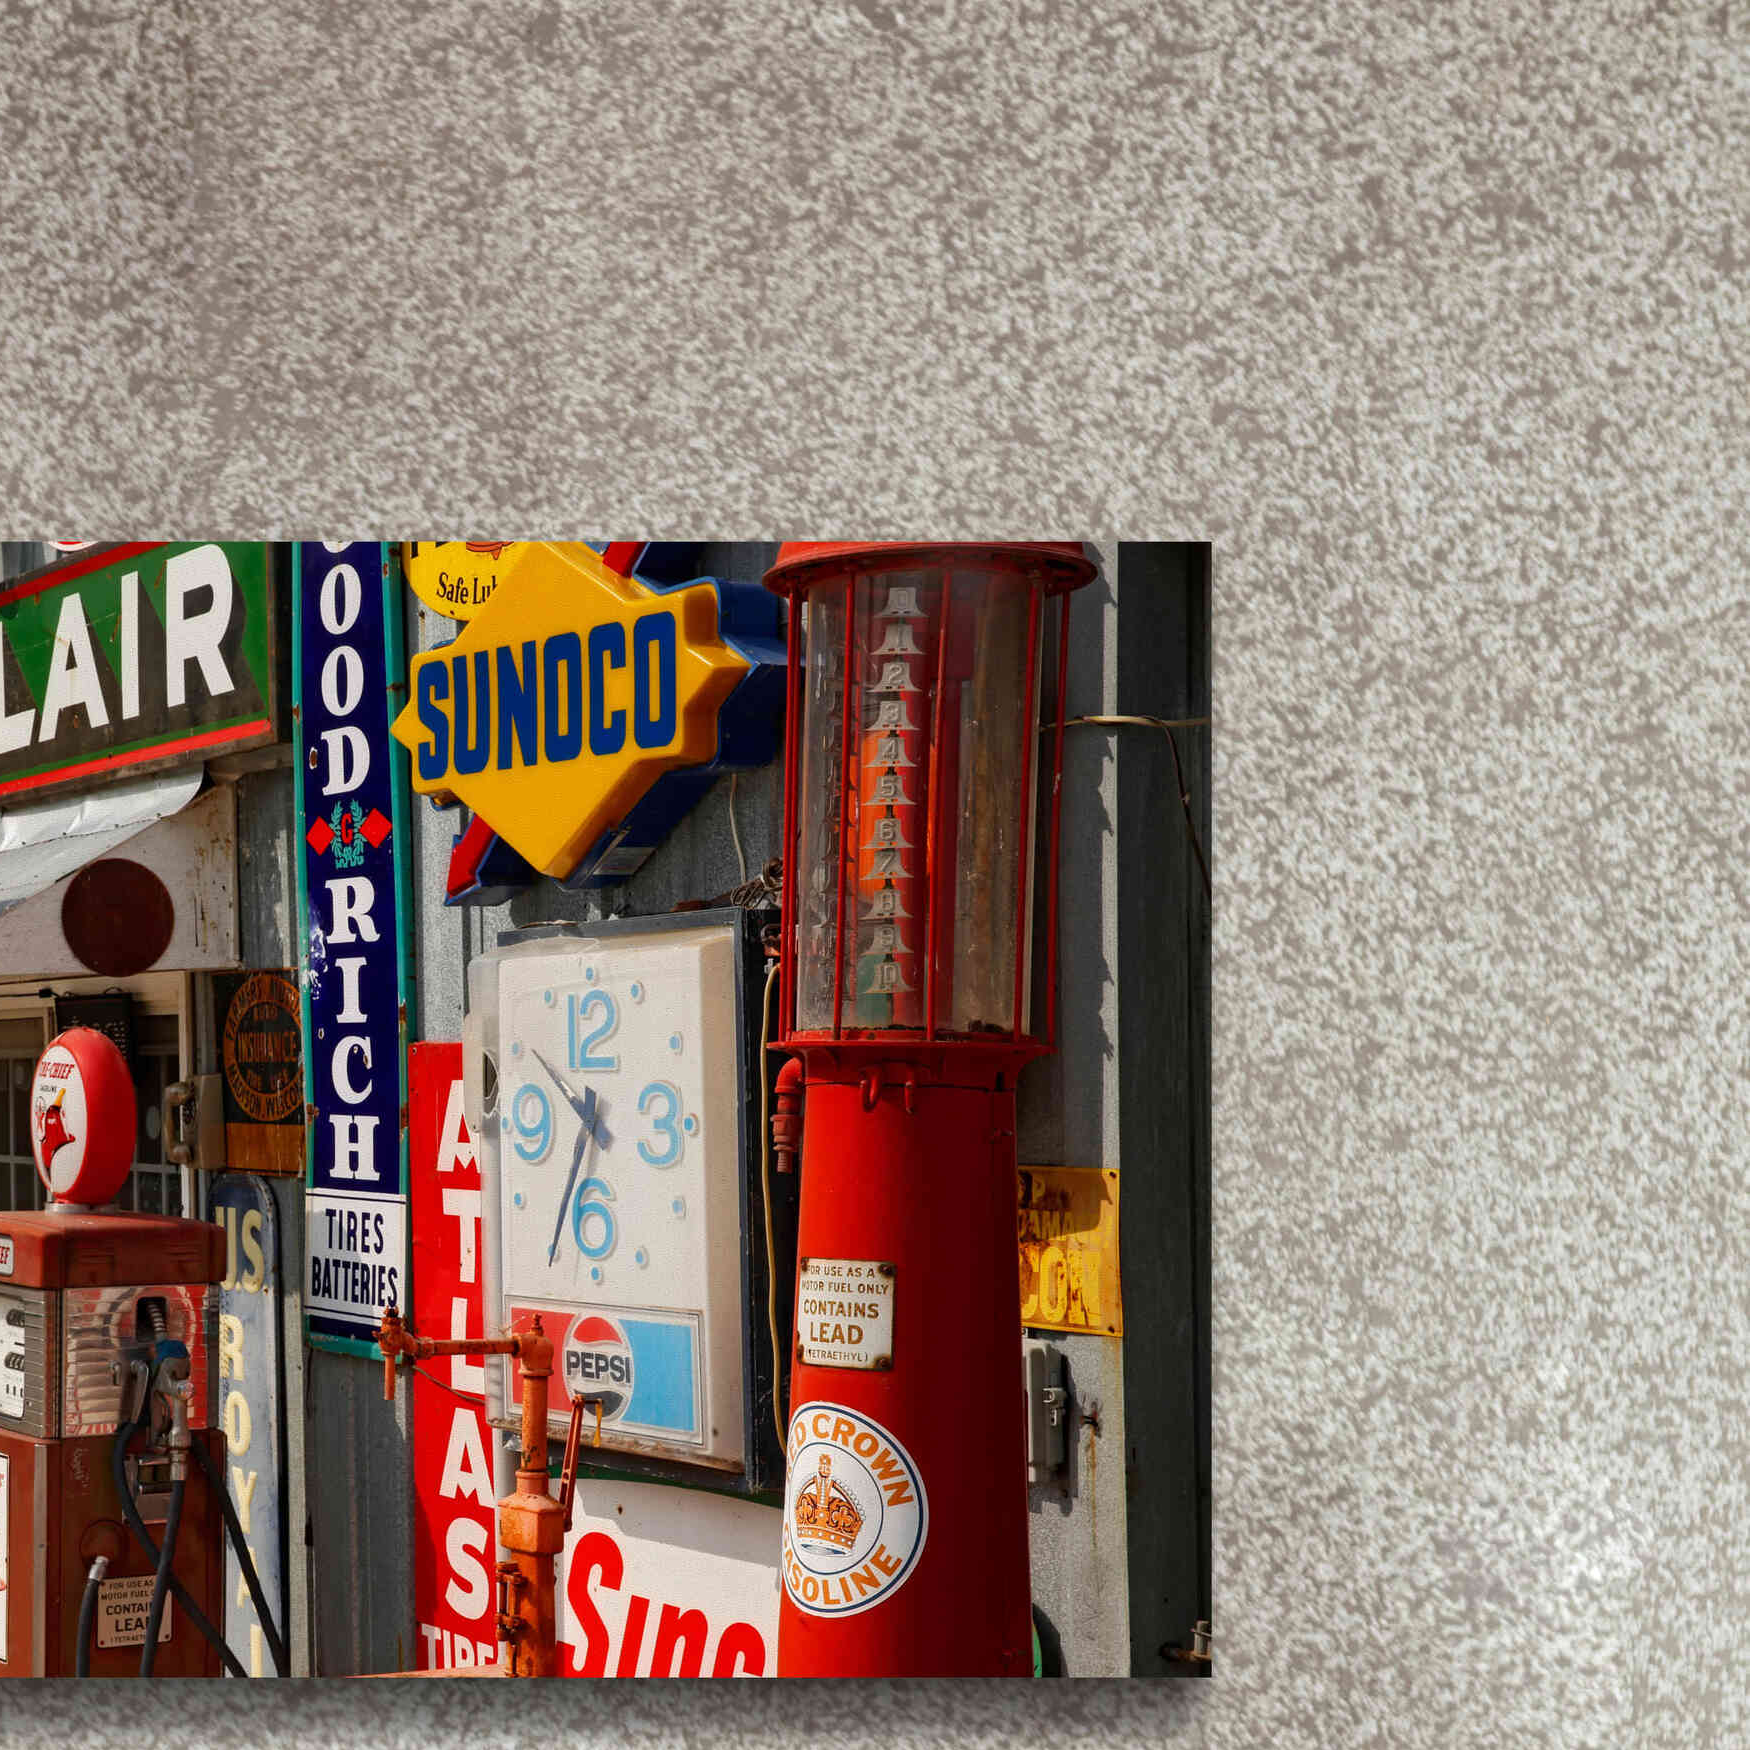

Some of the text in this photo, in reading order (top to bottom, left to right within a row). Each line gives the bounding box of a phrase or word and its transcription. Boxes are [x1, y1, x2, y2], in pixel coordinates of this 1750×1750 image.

[436, 572, 469, 604] Safe
[417, 611, 677, 781] SUNOCO
[880, 776, 898, 798] 5
[567, 989, 618, 1070] 12
[512, 1083, 551, 1161] 9
[636, 1082, 682, 1166] 3
[325, 1208, 384, 1255] TIRES
[572, 1177, 615, 1259] 6
[311, 1255, 398, 1308] BATTERIES
[801, 1280, 889, 1295] MOTOR FUEL ONLY
[806, 1265, 875, 1279] FOR USE AS A
[803, 1298, 880, 1319] CONTAINS
[436, 1079, 497, 1621] ATLAS
[809, 1321, 864, 1345] LEAD
[566, 1350, 631, 1384] PEPSI
[812, 1413, 914, 1508] CROWN
[100, 1591, 128, 1600] MOTOR
[130, 1590, 149, 1599] FUEL
[106, 1601, 152, 1616] CONTAI
